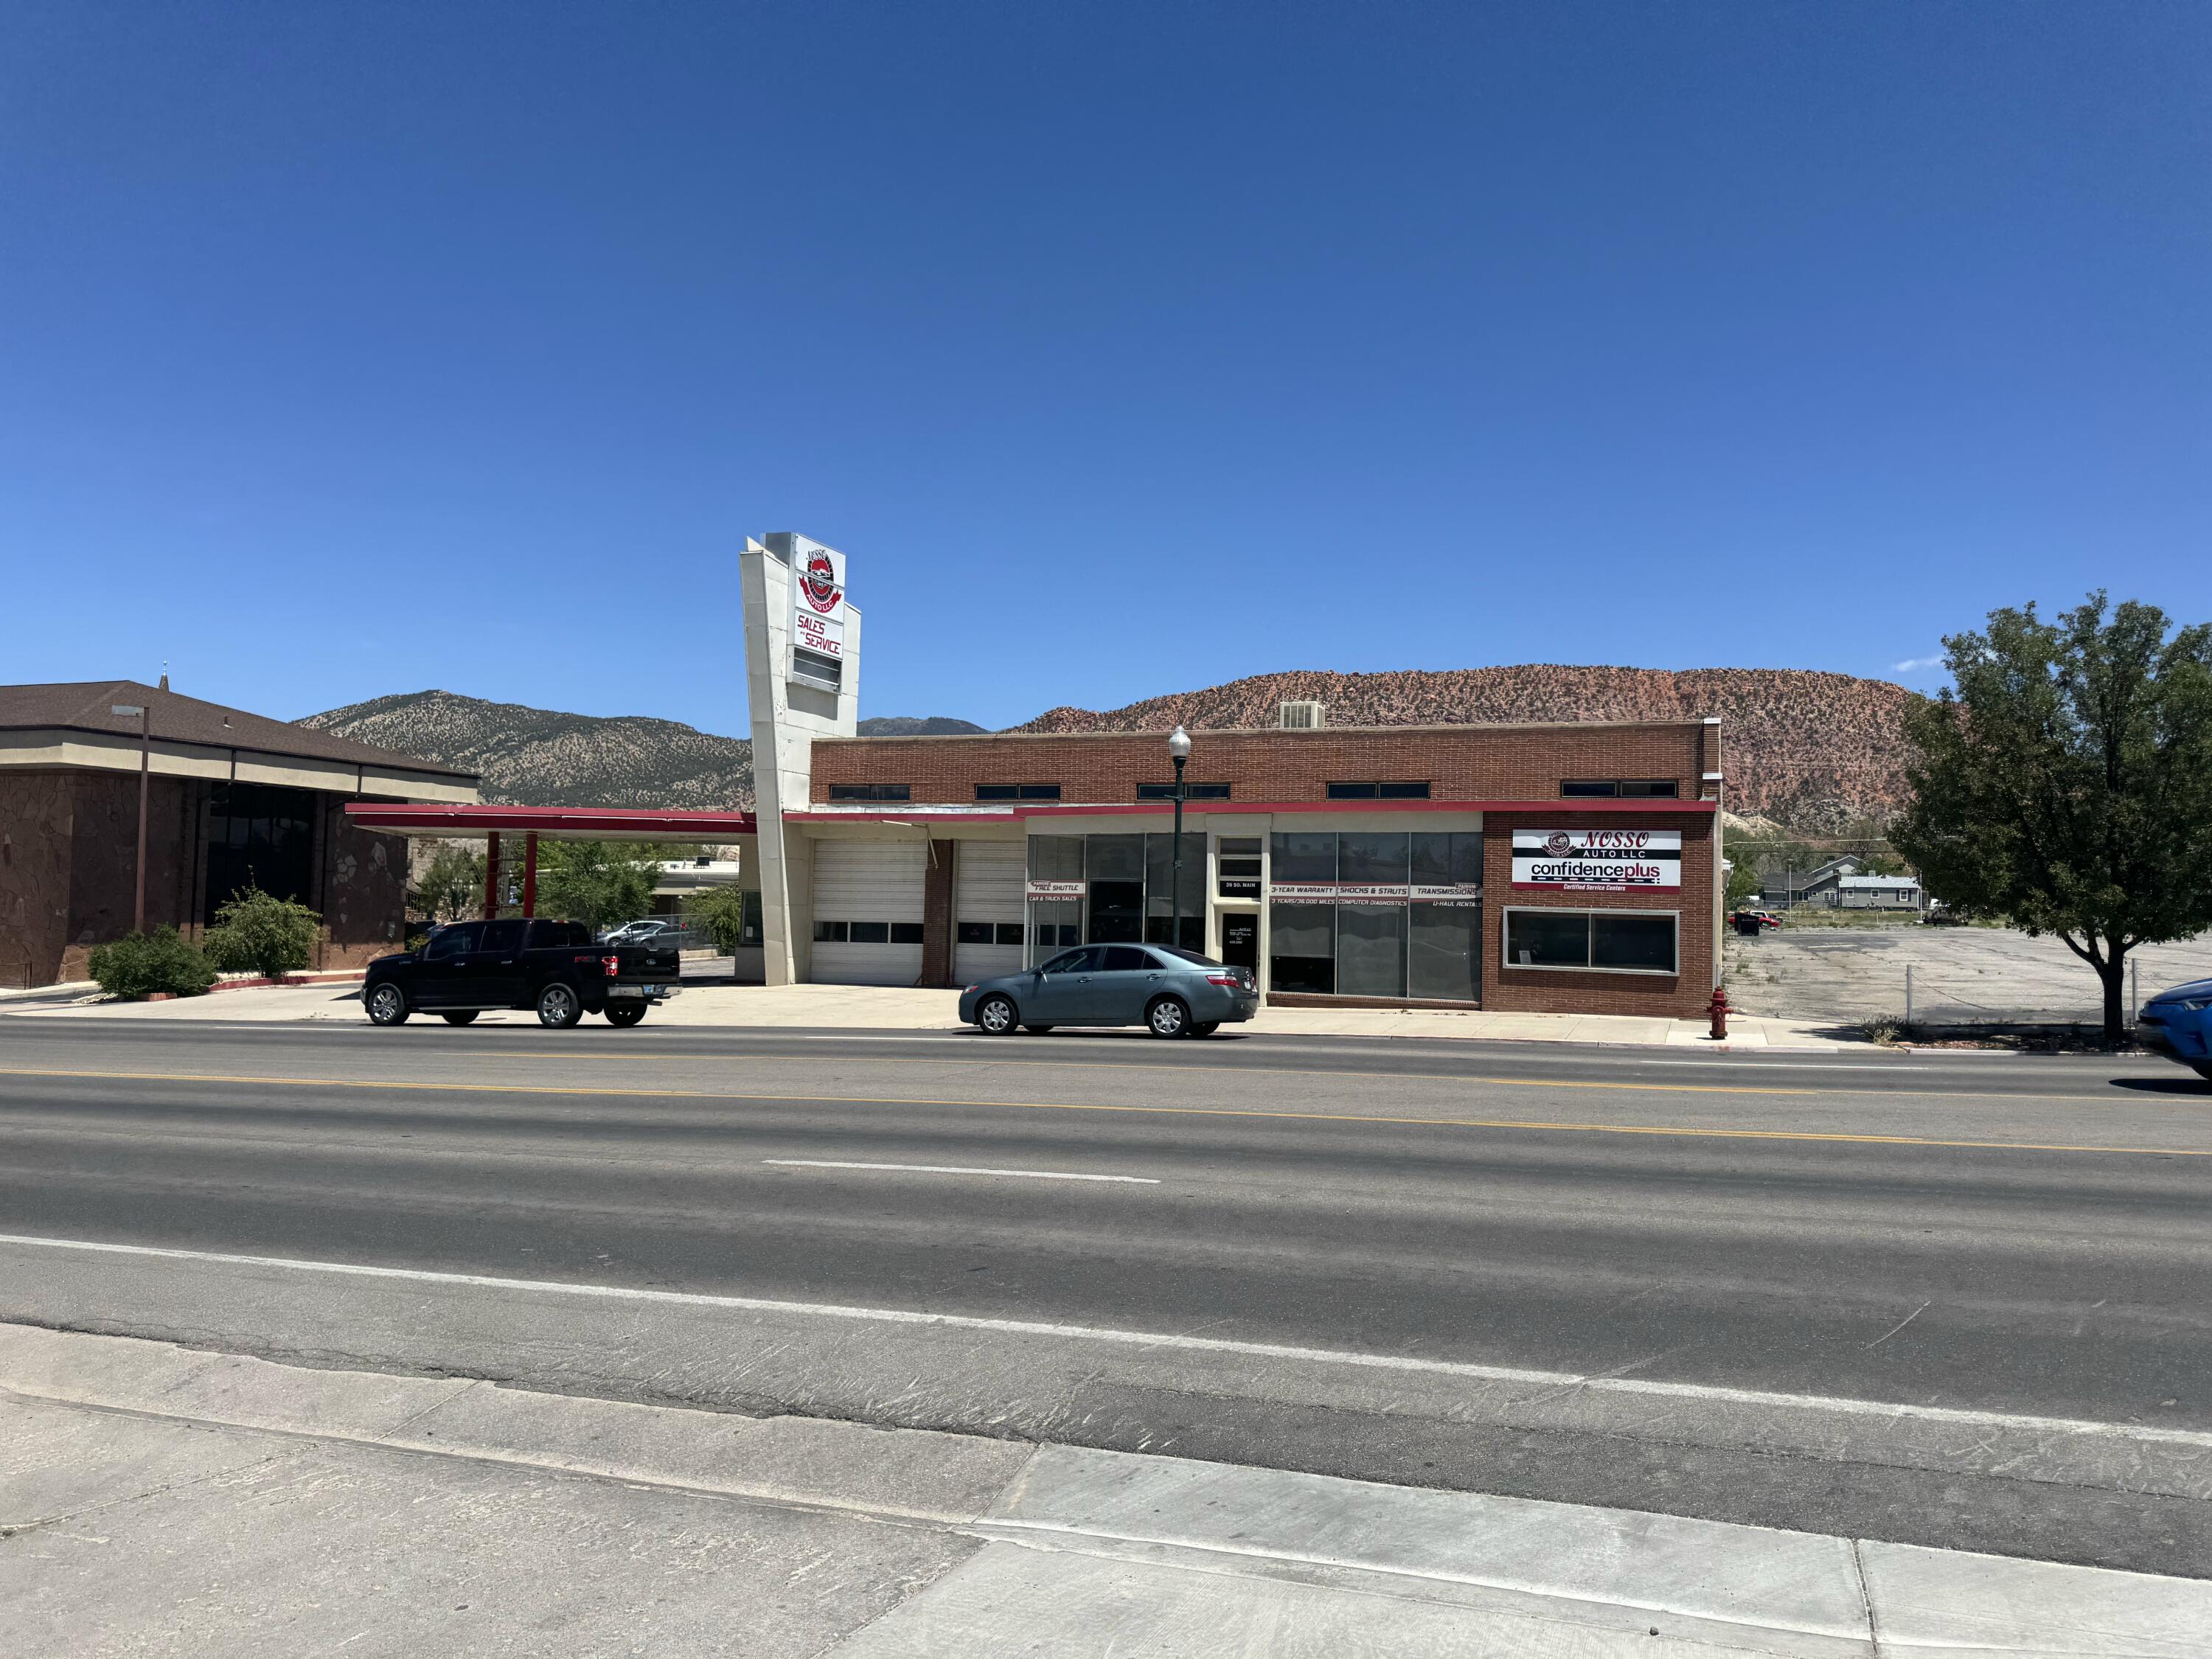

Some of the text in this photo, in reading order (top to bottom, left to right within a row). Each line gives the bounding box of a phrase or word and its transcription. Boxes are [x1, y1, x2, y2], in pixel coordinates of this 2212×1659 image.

[807, 594, 833, 611] AUTO LLC
[798, 615, 825, 635] SALES
[804, 633, 841, 655] SERVICE
[1581, 831, 1649, 848] NOSSO
[1622, 850, 1646, 858] LLC
[1531, 861, 1660, 881] confidenceplus
